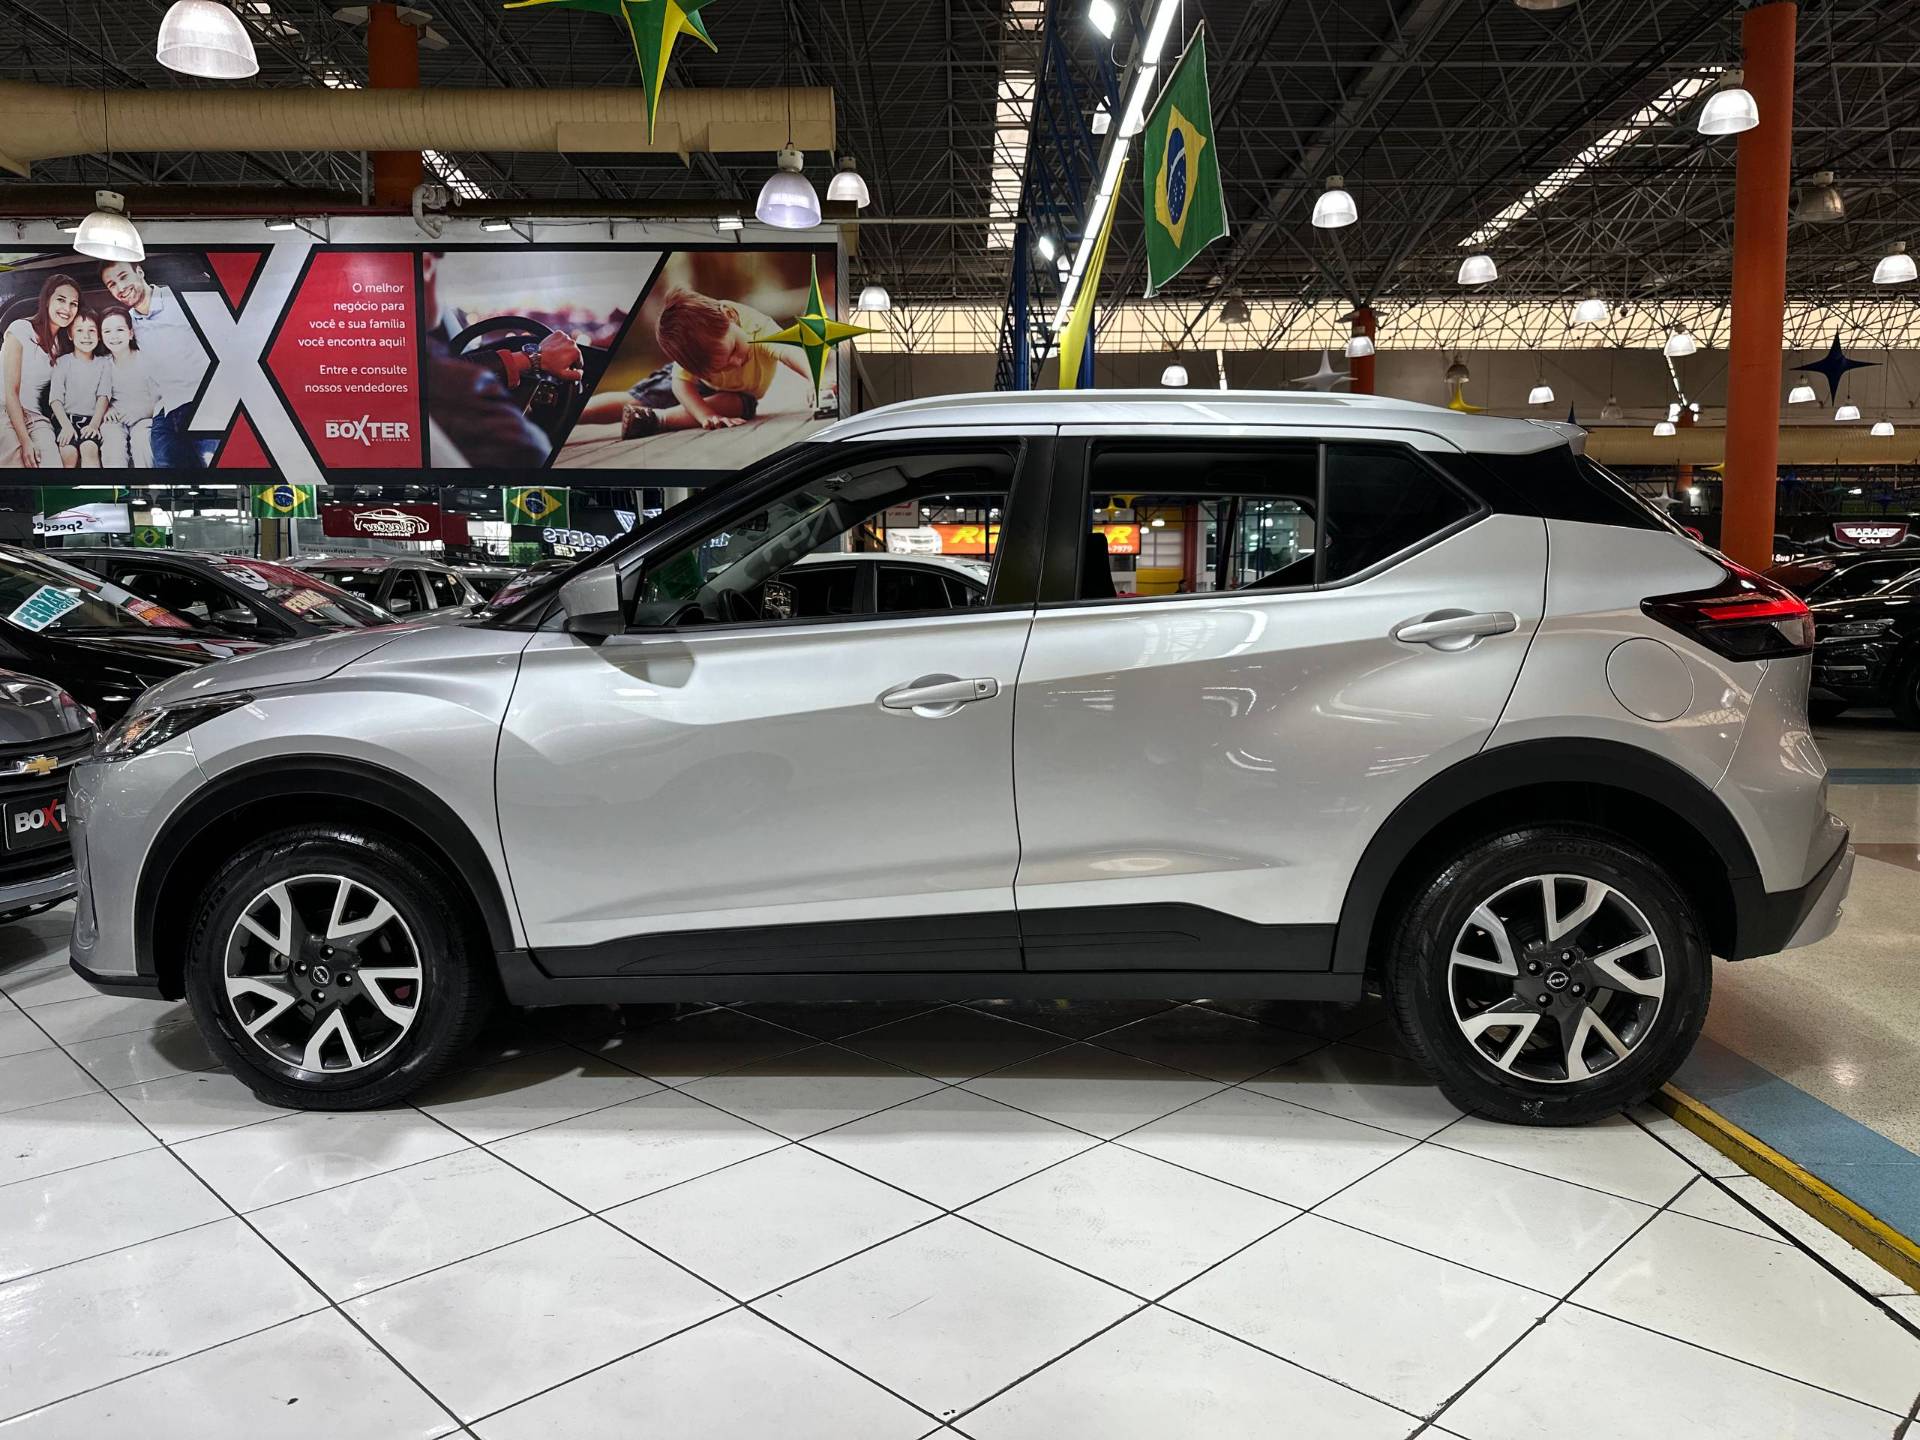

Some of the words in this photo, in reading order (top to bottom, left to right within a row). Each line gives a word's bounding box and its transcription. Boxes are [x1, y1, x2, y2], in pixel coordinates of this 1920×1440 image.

[352, 283, 362, 293] O
[365, 283, 404, 293] melhor
[333, 301, 378, 313] negócio
[381, 303, 405, 312] para
[309, 319, 336, 329] você
[338, 321, 345, 329] e
[348, 321, 367, 329] sua
[369, 319, 406, 329] família
[298, 337, 325, 347] você
[327, 337, 377, 347] encontra
[379, 337, 406, 348] aqui!
[319, 365, 349, 375] Entre
[351, 367, 358, 375] e
[360, 365, 408, 375] consulte
[305, 384, 342, 393] nossos
[344, 383, 408, 393] vendedores
[325, 414, 410, 446] BOXTER
